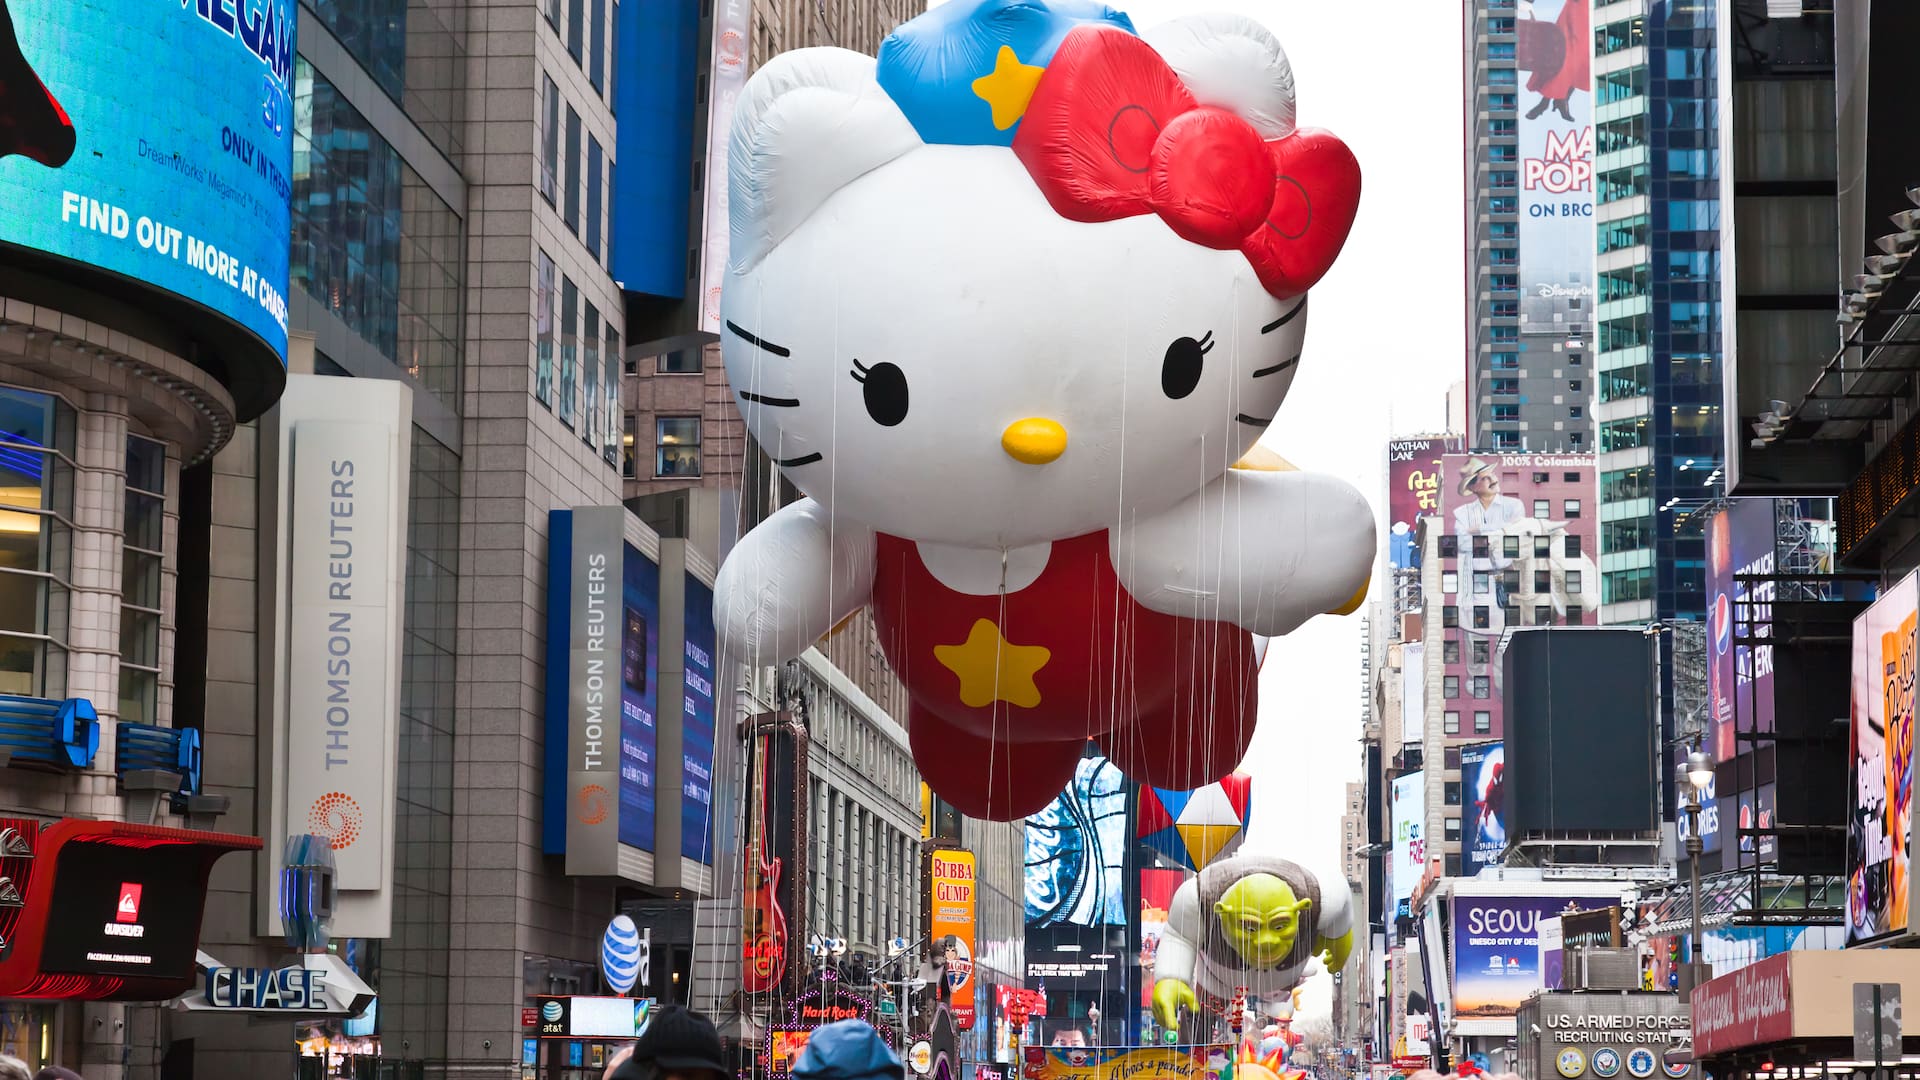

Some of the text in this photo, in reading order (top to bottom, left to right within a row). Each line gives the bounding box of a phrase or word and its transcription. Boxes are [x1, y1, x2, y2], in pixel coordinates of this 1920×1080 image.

[262, 73, 284, 139] 3D
[222, 126, 254, 167] ONLY
[257, 149, 267, 179] IN
[1524, 158, 1592, 194] POP
[1529, 203, 1555, 217] ON
[62, 191, 129, 239] FIND
[136, 216, 183, 259] OUT
[187, 236, 239, 289] MORE
[241, 265, 257, 299] AT
[1536, 282, 1580, 300] Disney
[1390, 440, 1430, 451] NATHAN
[1391, 451, 1414, 461] LANE
[1502, 456, 1531, 466] 100%
[1752, 551, 1774, 576] MUCH
[325, 459, 354, 771] THOMSON REUTERS
[585, 553, 606, 770] THOMSON REUTERS
[934, 858, 973, 880] BUBBA
[937, 882, 970, 902] GUMP
[939, 907, 968, 915] SHRIMP
[1469, 938, 1496, 946] UNESCO
[1497, 938, 1513, 946] CITY
[1513, 938, 1523, 946] OF
[954, 960, 972, 974] GUMP
[206, 966, 328, 1009] CHASE
[802, 1005, 858, 1021] Hard Rock
[1694, 966, 1786, 1052] Walgreens Walgreens
[543, 1023, 563, 1033] at&t
[1576, 1015, 1634, 1028] ARMED
[1636, 1015, 1691, 1029] FORCE
[1554, 1031, 1634, 1043] RECRUITING
[1122, 1059, 1145, 1079] loves
[1147, 1060, 1154, 1069] a
